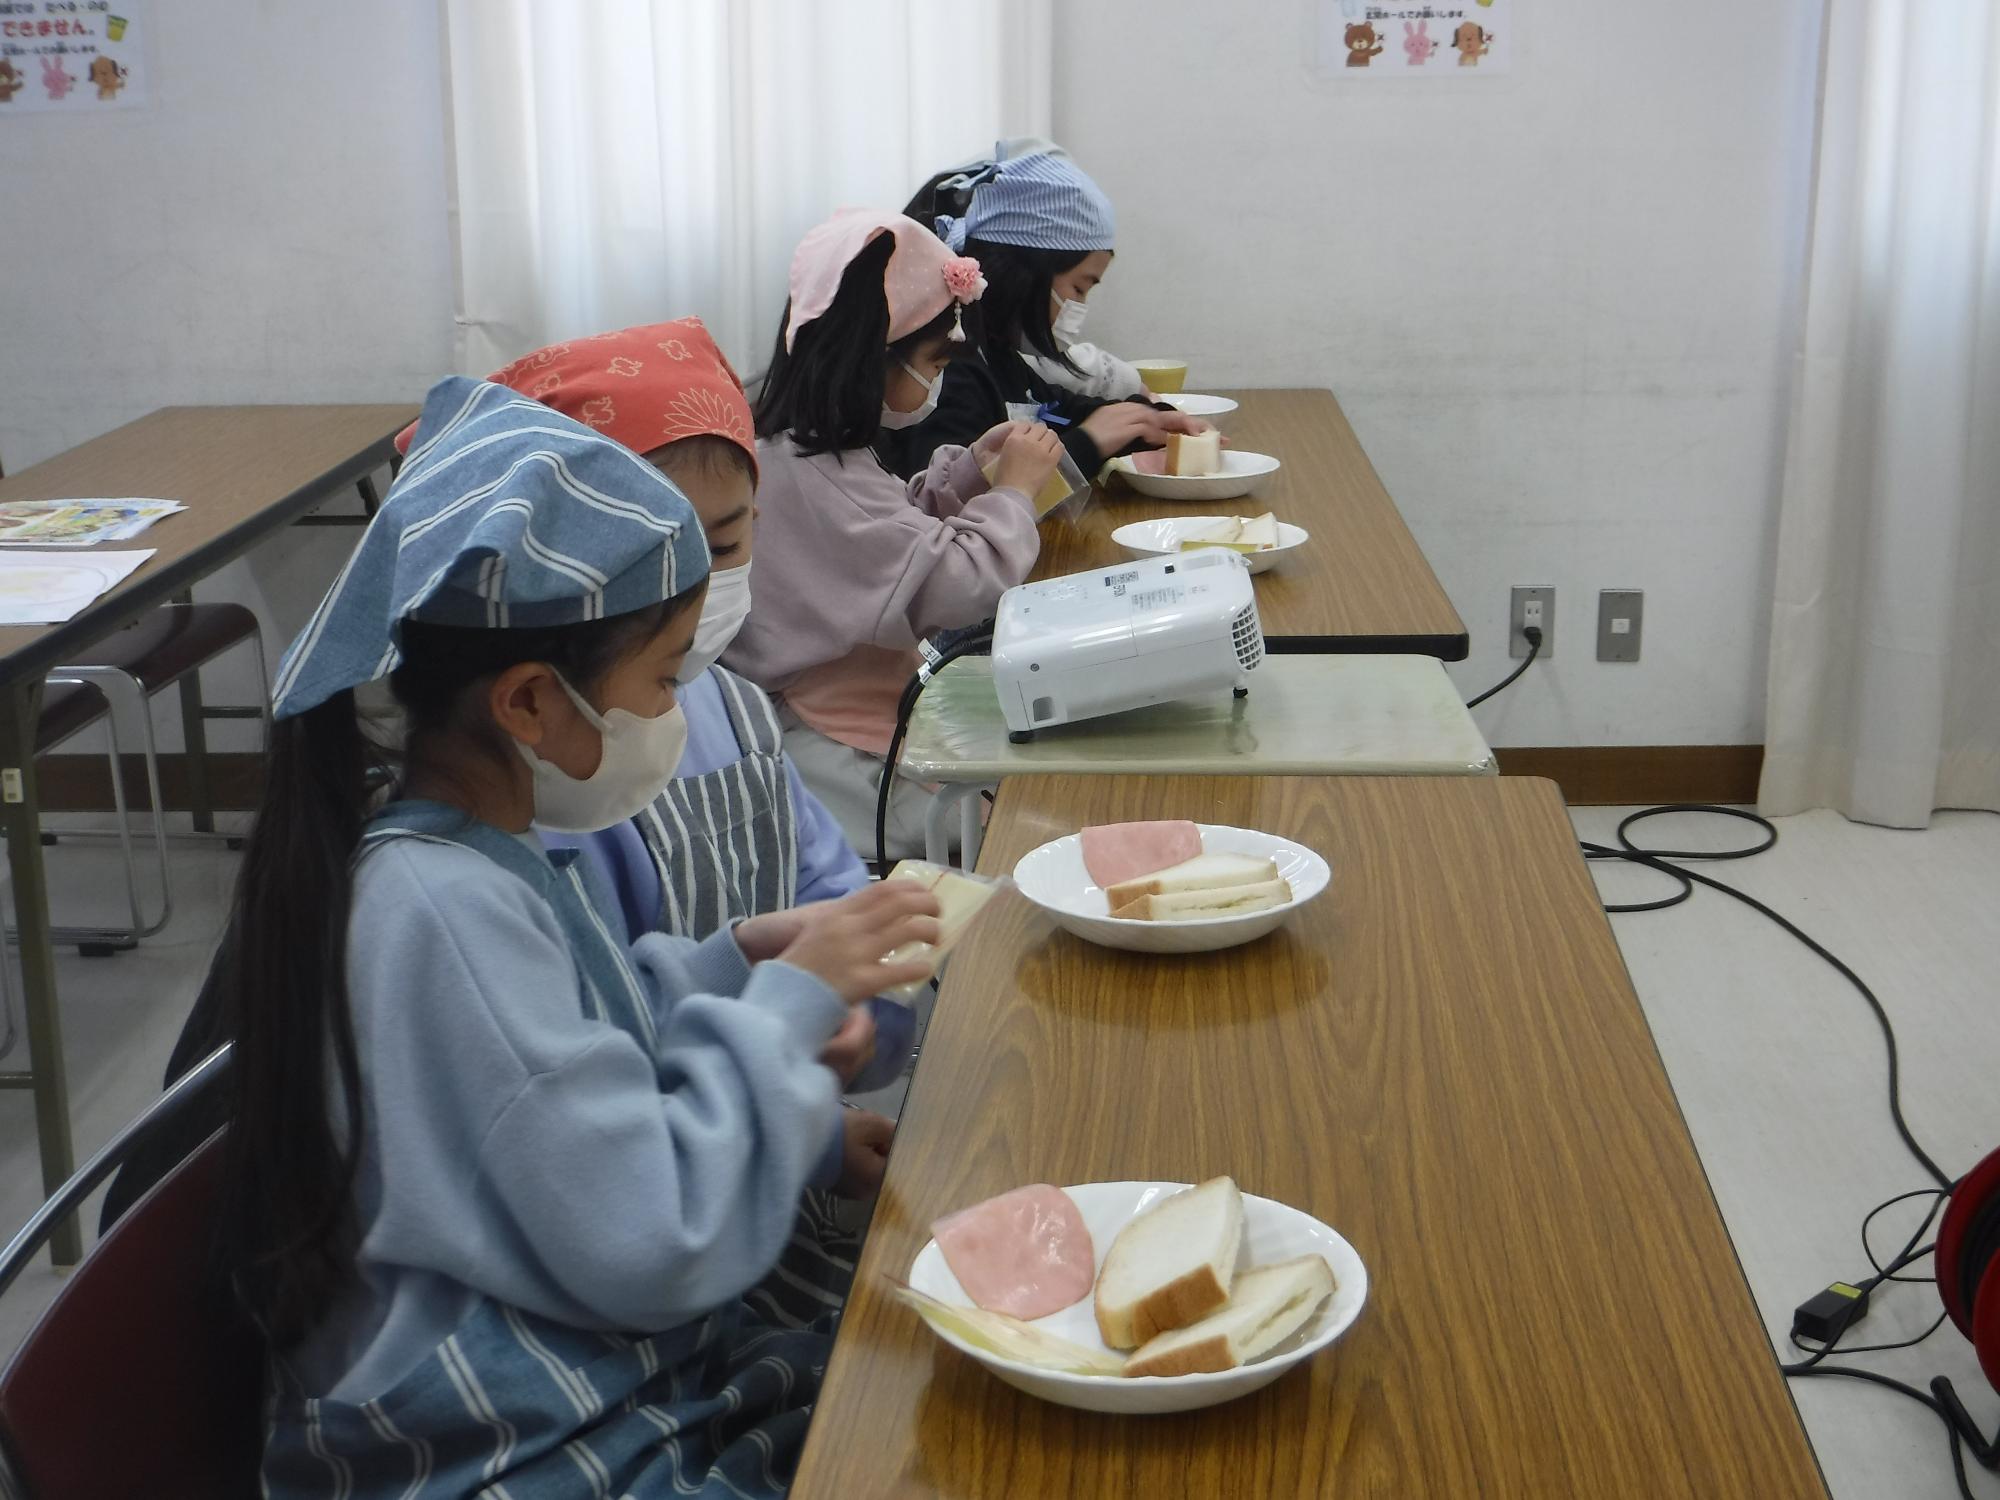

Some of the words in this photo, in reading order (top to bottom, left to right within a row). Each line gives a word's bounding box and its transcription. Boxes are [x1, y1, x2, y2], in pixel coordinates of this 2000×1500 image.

[2, 18, 95, 37] できません。
